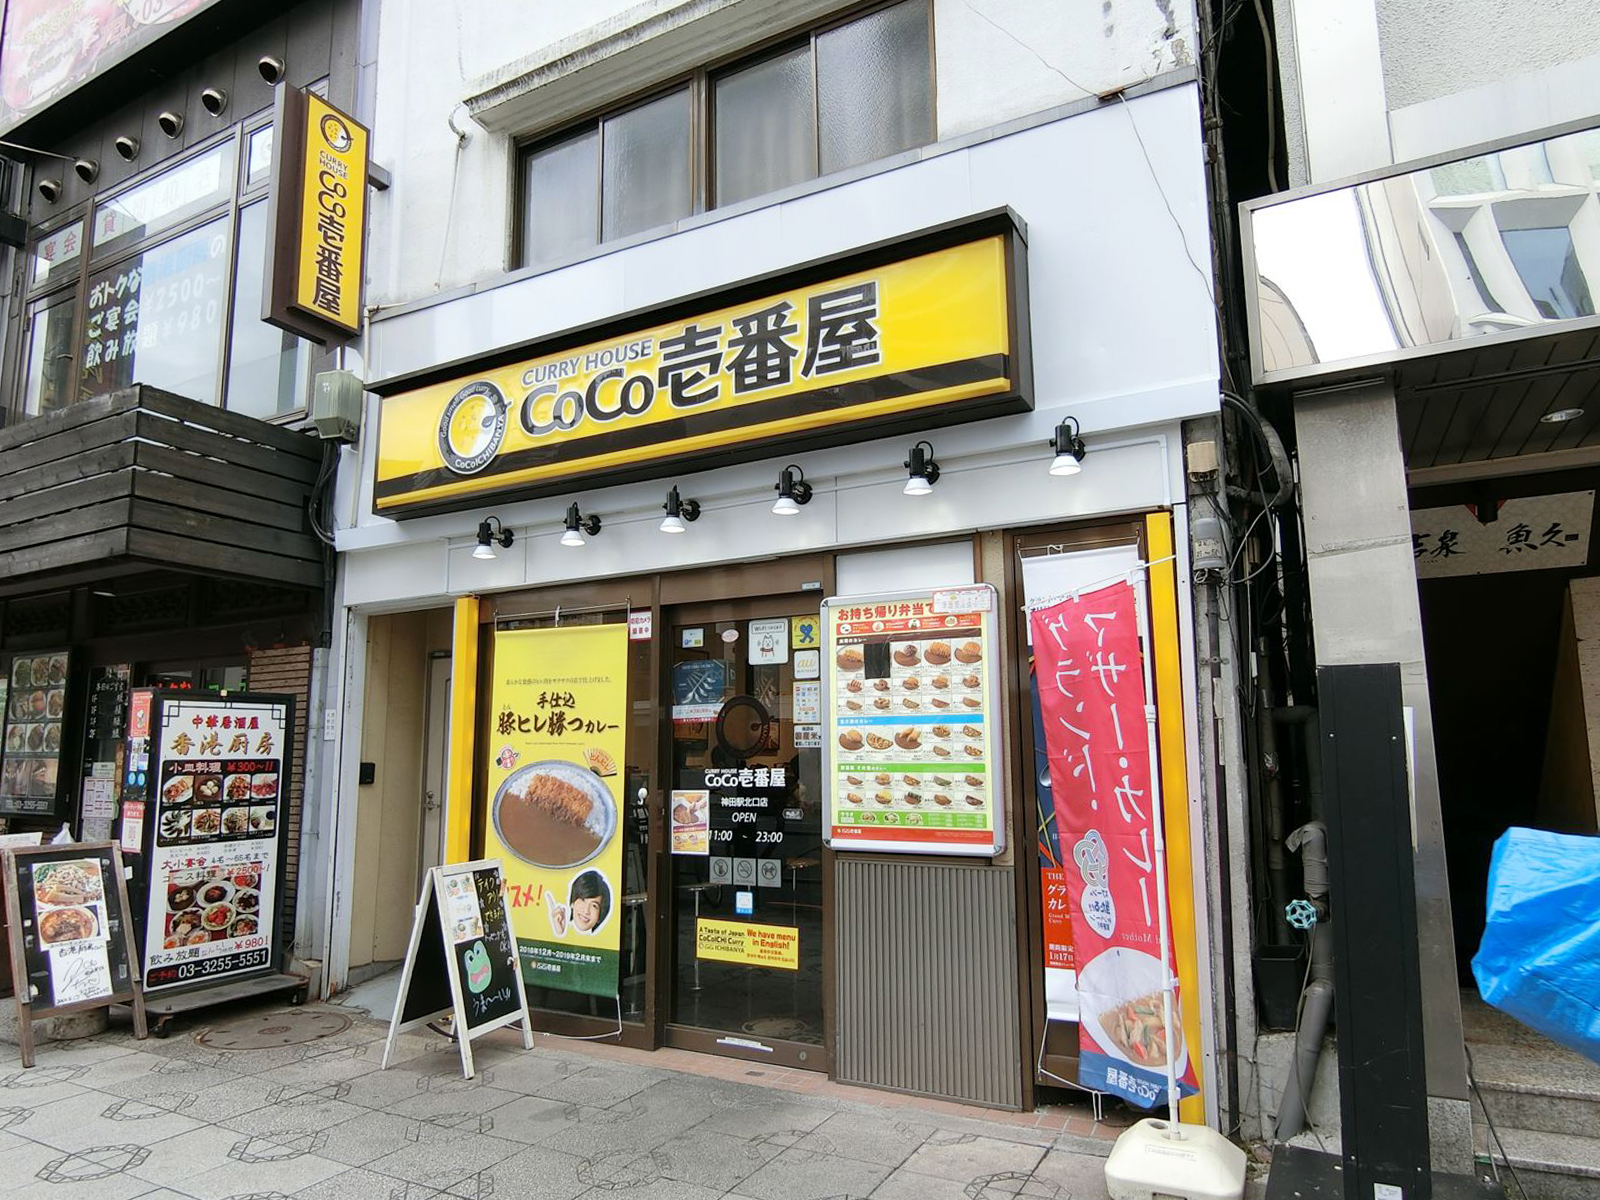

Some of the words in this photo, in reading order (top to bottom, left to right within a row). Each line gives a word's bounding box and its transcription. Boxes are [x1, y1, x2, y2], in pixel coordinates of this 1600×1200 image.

[317, 159, 350, 181] HOUSE
[318, 149, 349, 172] CURRY
[311, 169, 349, 316] CoCo壱番屋
[89, 267, 143, 310] おトクな
[88, 299, 141, 340] ご宴会
[85, 321, 158, 369] 飲み放題
[520, 281, 881, 436] CoCo壱番屋
[522, 357, 580, 386] CURRY
[585, 339, 653, 371] HOUSE
[454, 414, 505, 469] CoCoICHIBANYA
[1499, 522, 1566, 555] 魚久
[537, 691, 576, 709] 手仕込
[192, 714, 260, 730] 中華居酒屋
[496, 710, 620, 736] 豚ヒレ勝つカレー
[169, 731, 276, 757] 香港厨房
[168, 761, 223, 774] 小皿料理
[704, 768, 787, 788] CoCo壱番屋
[731, 812, 757, 823] OPEN
[708, 830, 733, 841] 11:00
[755, 831, 784, 843] 23:00
[162, 869, 217, 883] コース料理
[1046, 871, 1064, 880] THE
[704, 926, 720, 934] Taste
[746, 928, 757, 937] We
[758, 930, 775, 940] have
[776, 933, 796, 942] menu
[727, 937, 745, 946] Curry
[752, 938, 759, 946] in
[760, 939, 790, 950] English!
[149, 946, 201, 966] 飲み放題
[178, 949, 267, 979] 03-3255-5551
